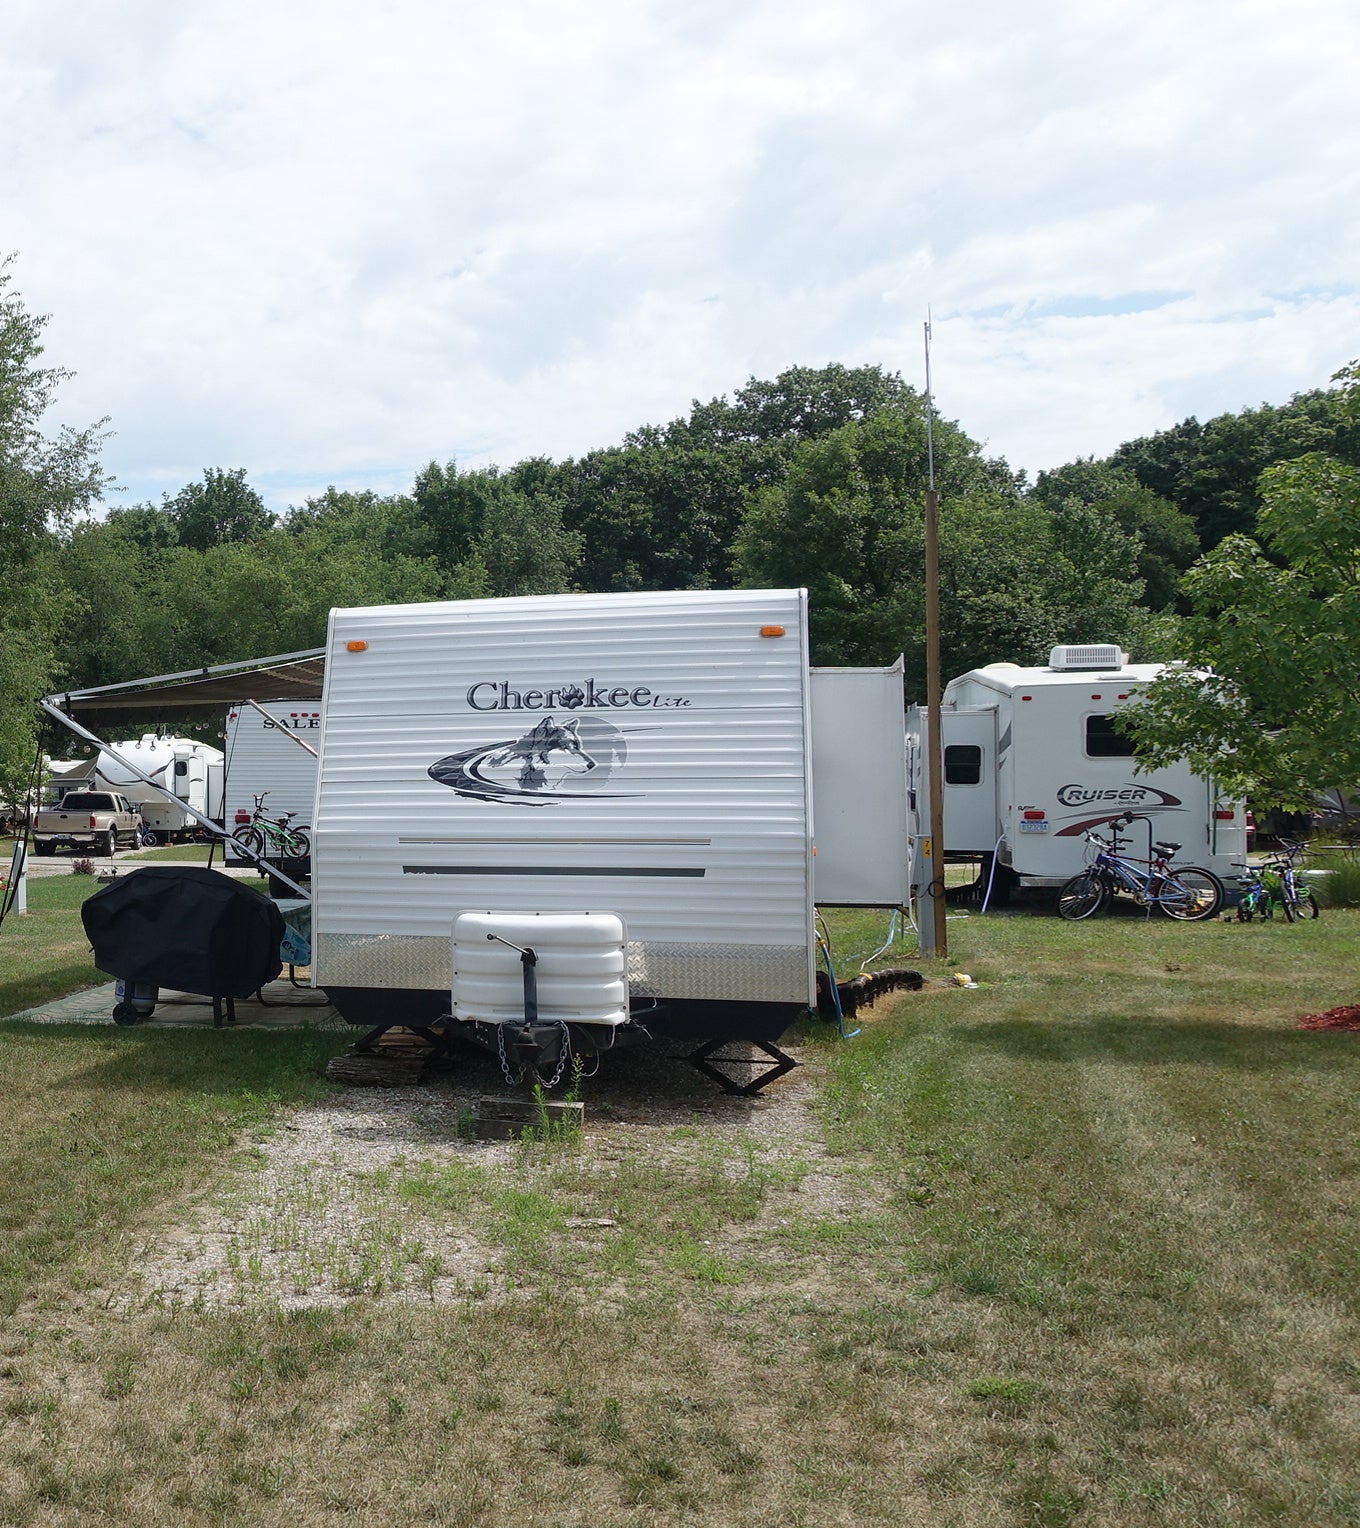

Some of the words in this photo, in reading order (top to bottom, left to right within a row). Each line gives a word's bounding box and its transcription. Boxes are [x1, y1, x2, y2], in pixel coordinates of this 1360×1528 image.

[653, 695, 692, 707] Lite
[264, 719, 320, 729] SALE
[1057, 784, 1147, 807] CRUISER
